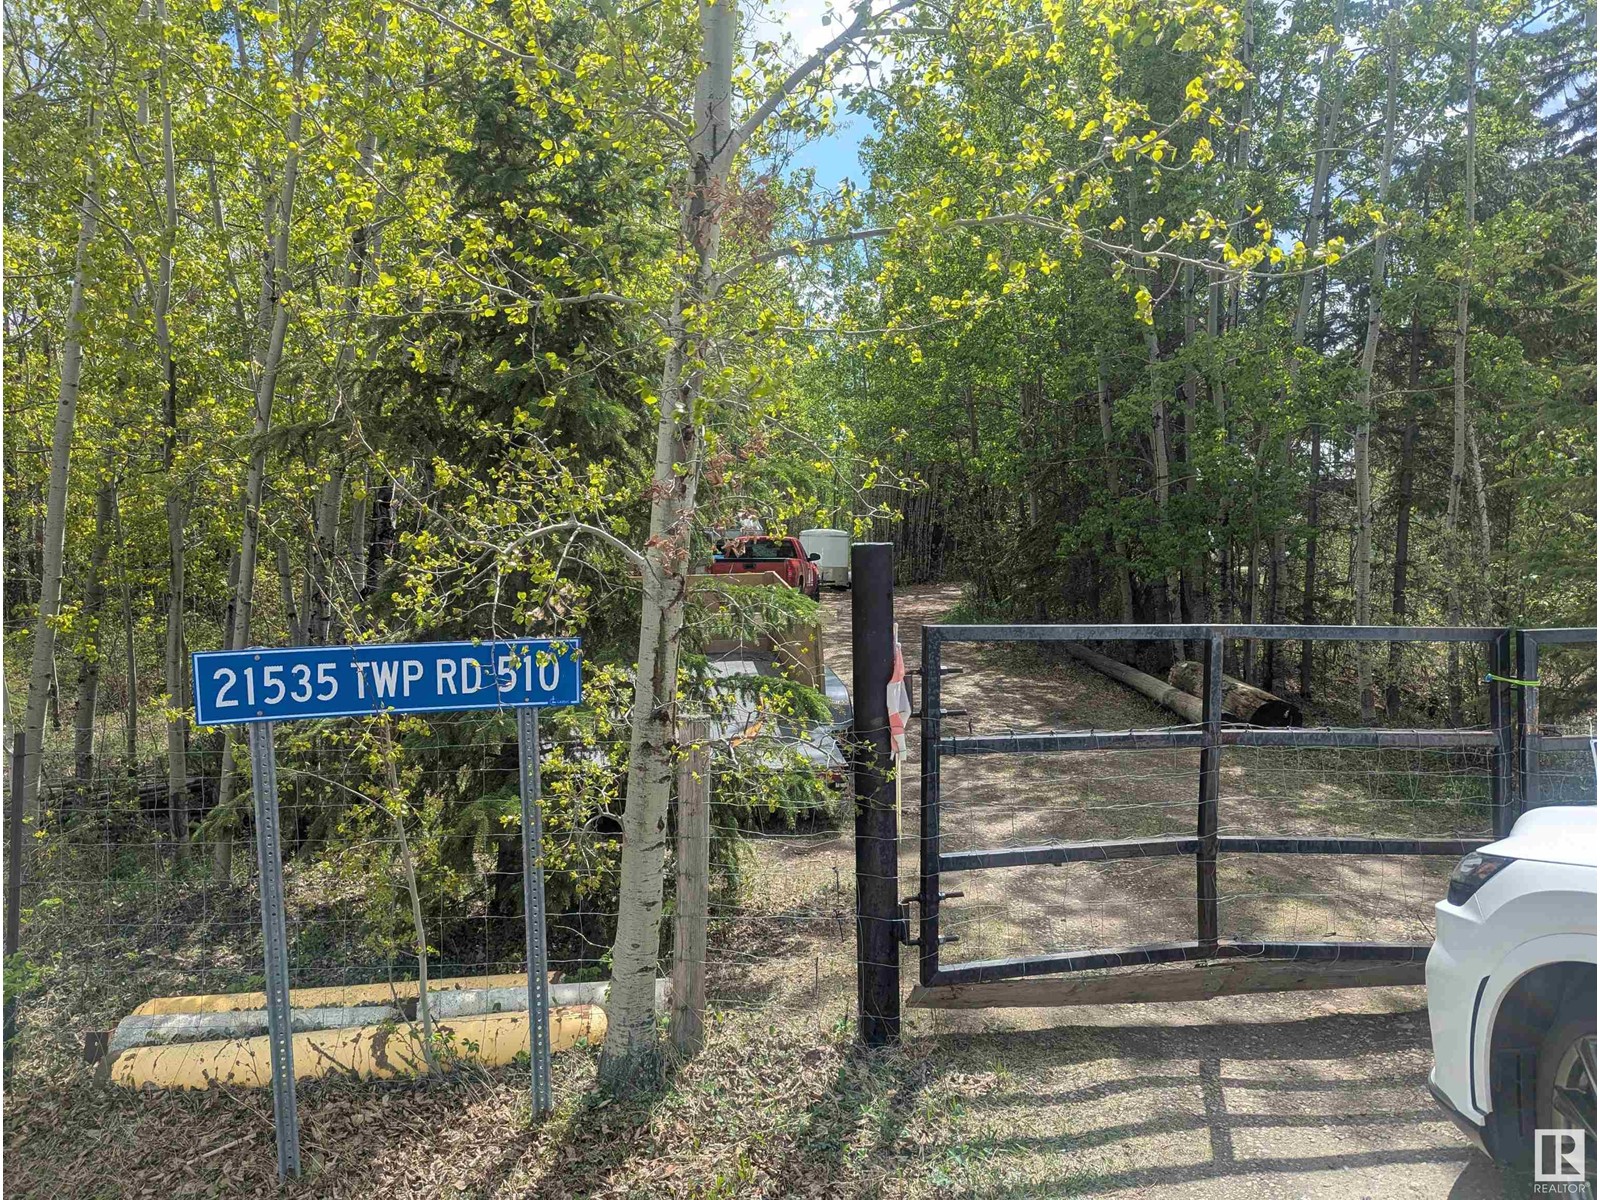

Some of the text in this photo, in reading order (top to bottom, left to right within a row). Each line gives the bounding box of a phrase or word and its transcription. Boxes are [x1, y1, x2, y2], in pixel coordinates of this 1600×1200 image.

[213, 653, 560, 708] 21535 TWP RD 510
